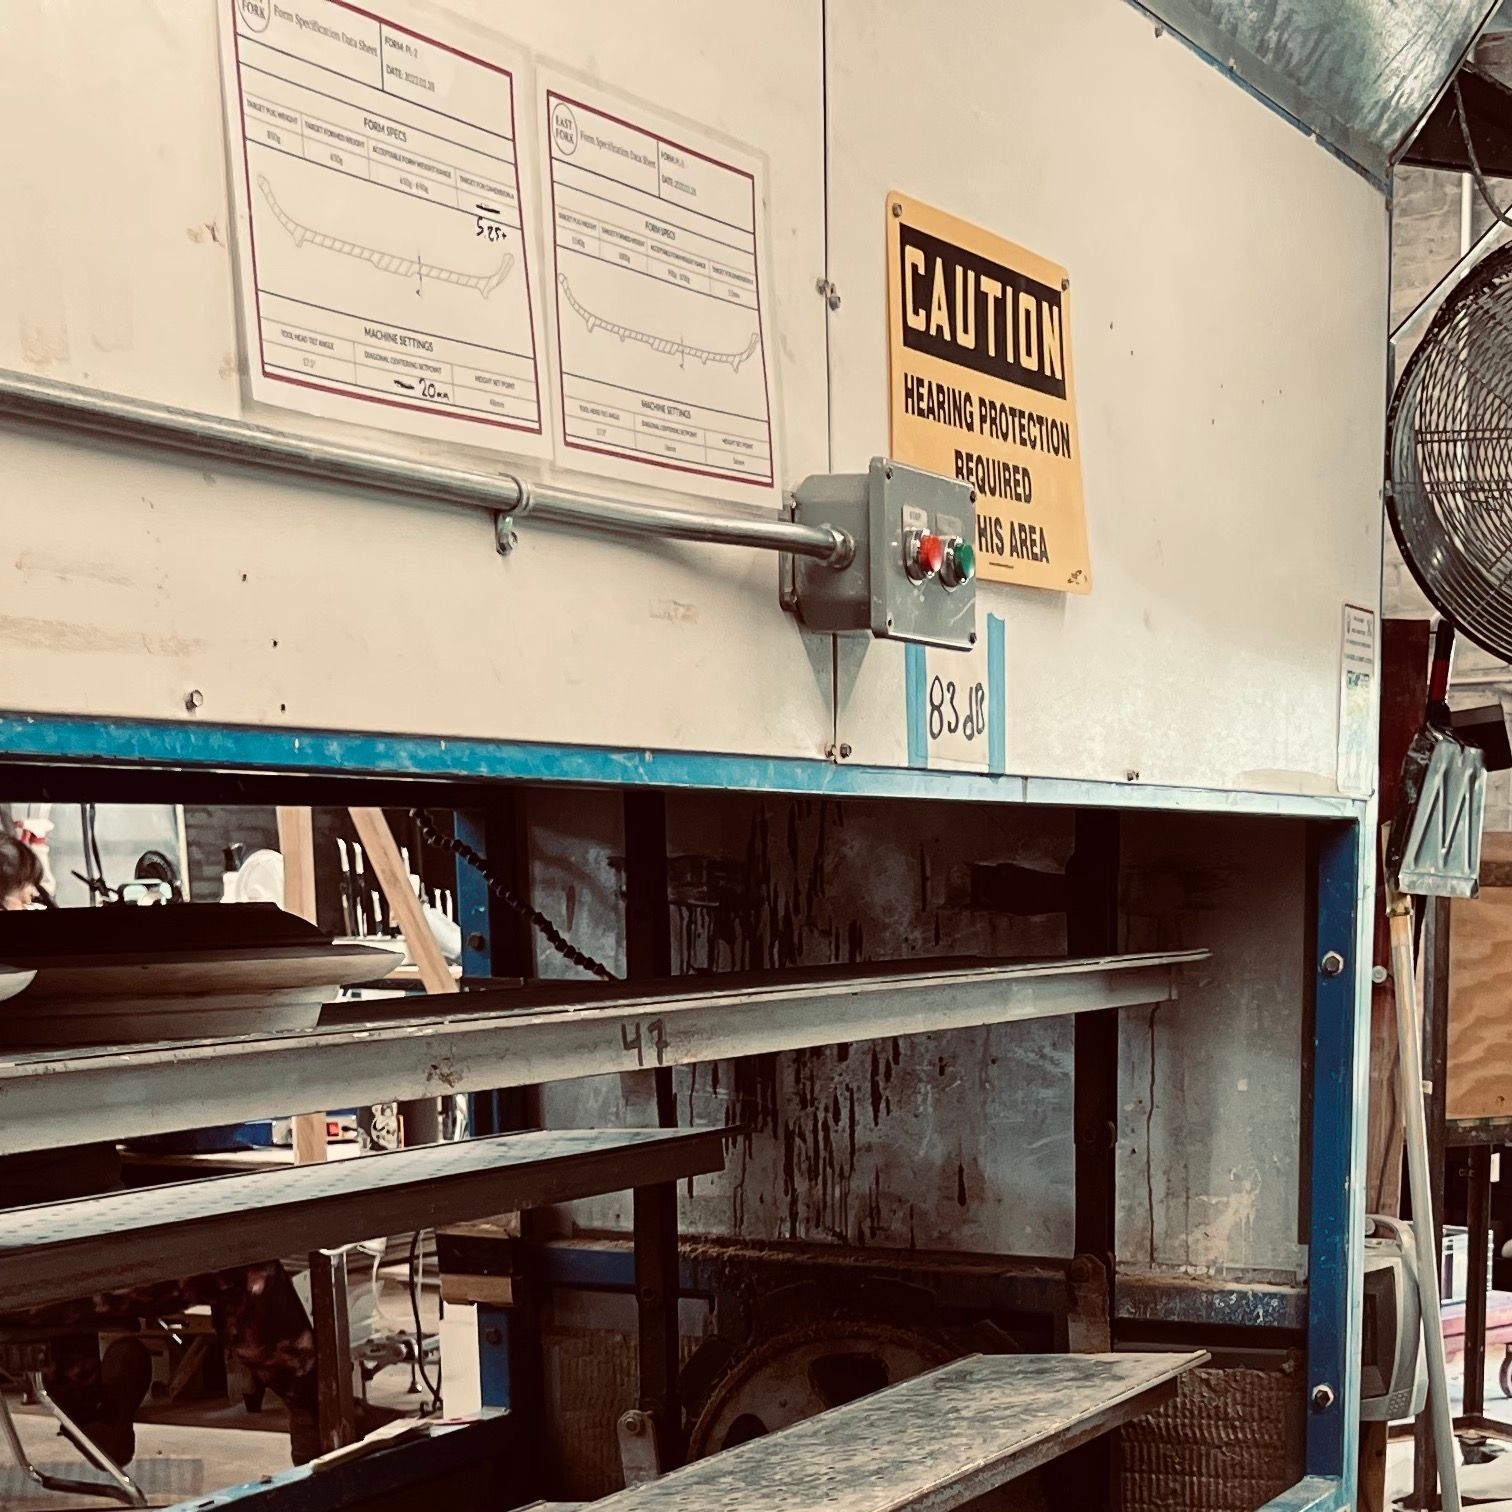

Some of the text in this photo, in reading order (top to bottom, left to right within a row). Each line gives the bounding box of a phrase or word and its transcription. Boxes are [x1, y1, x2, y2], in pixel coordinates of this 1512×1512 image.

[242, 2, 266, 20] FORK
[274, 6, 293, 25] Form
[296, 12, 340, 42] Specification
[342, 29, 359, 49] Data
[364, 117, 407, 143] FORM SPECS
[555, 114, 573, 130] EAST
[555, 128, 575, 145] FORK
[580, 130, 595, 144] Form
[595, 137, 630, 159] Specification
[645, 221, 676, 241] FORM SPECS
[904, 244, 1063, 380] CAUTION
[364, 326, 434, 353] MACHINE SETTINGS
[641, 399, 692, 420] MACHINE SETTINGS
[903, 372, 1072, 459] HEARING PROTECTION
[954, 449, 1033, 505] REQUIRED
[977, 514, 1050, 565] HIS AREA
